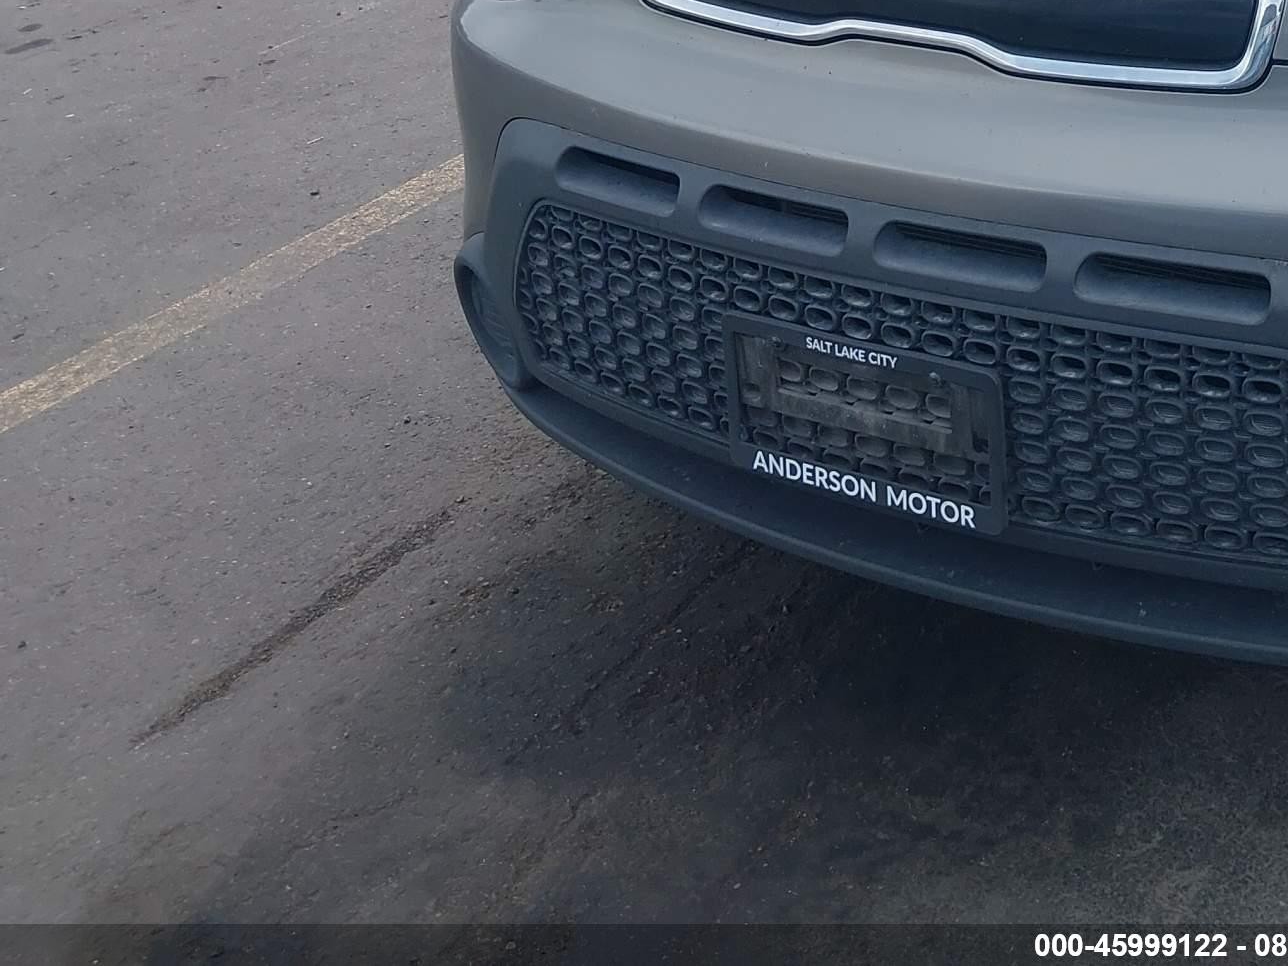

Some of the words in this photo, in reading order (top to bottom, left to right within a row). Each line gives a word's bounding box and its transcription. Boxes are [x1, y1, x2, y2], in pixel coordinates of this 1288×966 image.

[805, 336, 833, 355] SALT
[834, 343, 866, 363] LAKE
[868, 350, 898, 369] CITY
[752, 450, 877, 503] ANDERSON
[886, 485, 976, 528] MOTOR
